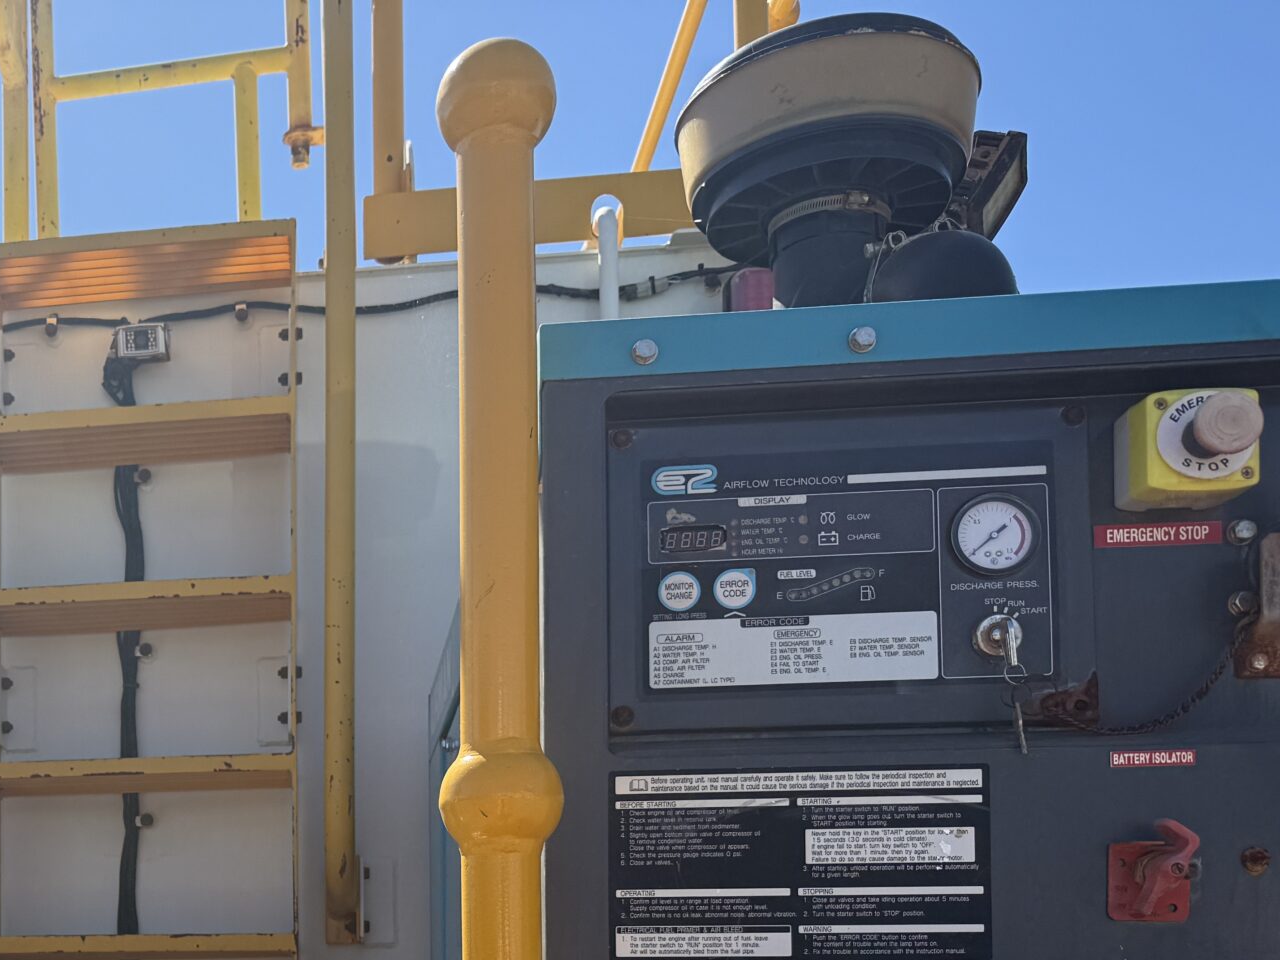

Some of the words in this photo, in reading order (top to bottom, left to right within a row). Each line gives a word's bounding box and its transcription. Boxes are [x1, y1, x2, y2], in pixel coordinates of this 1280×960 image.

[1182, 458, 1229, 471] STOP
[724, 480, 769, 489] AIRFLOW
[774, 476, 844, 487] TECHNOLOGY
[754, 497, 791, 505] DISPLAY
[847, 513, 870, 521] GLOW
[847, 533, 880, 541] CHARGE
[1106, 527, 1176, 543] EMERGENCY
[1179, 525, 1209, 540] STOP
[878, 569, 885, 577] F
[664, 583, 694, 591] MONITOR
[720, 580, 749, 588] ERROR
[951, 582, 1003, 590] DISCHARGE
[666, 592, 693, 600] CHANGE
[723, 589, 746, 598] CODE
[745, 619, 776, 627] ERROR
[1113, 752, 1150, 765] BATTERY
[1152, 751, 1194, 764] ISOLATOR
[909, 772, 934, 780] inspection
